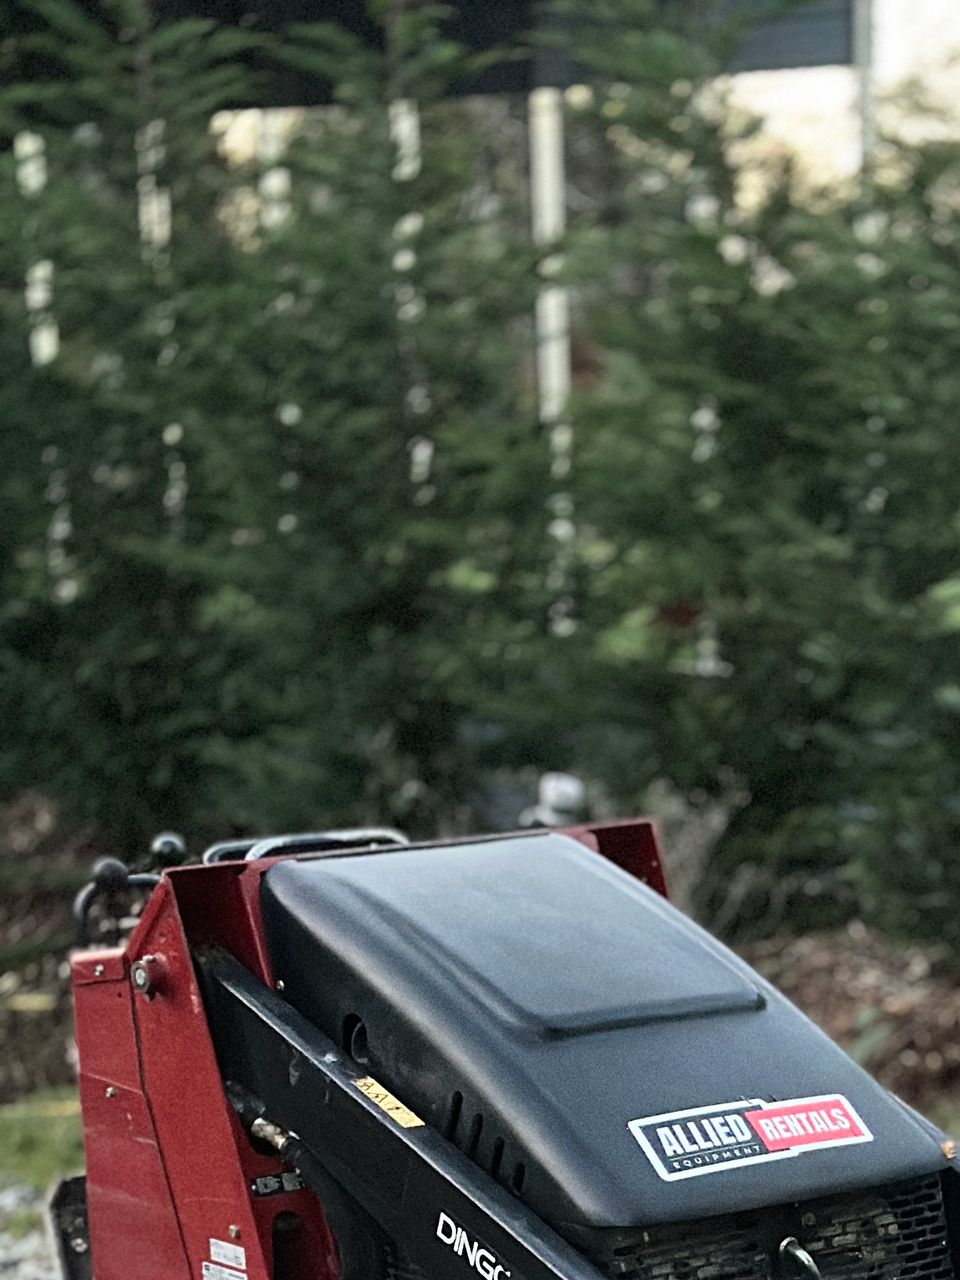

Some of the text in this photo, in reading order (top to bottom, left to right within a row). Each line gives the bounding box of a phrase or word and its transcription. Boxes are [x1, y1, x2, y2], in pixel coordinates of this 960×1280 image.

[656, 1107, 850, 1157] ALLIED RENTALS
[673, 1145, 760, 1169] EQUIPMENT
